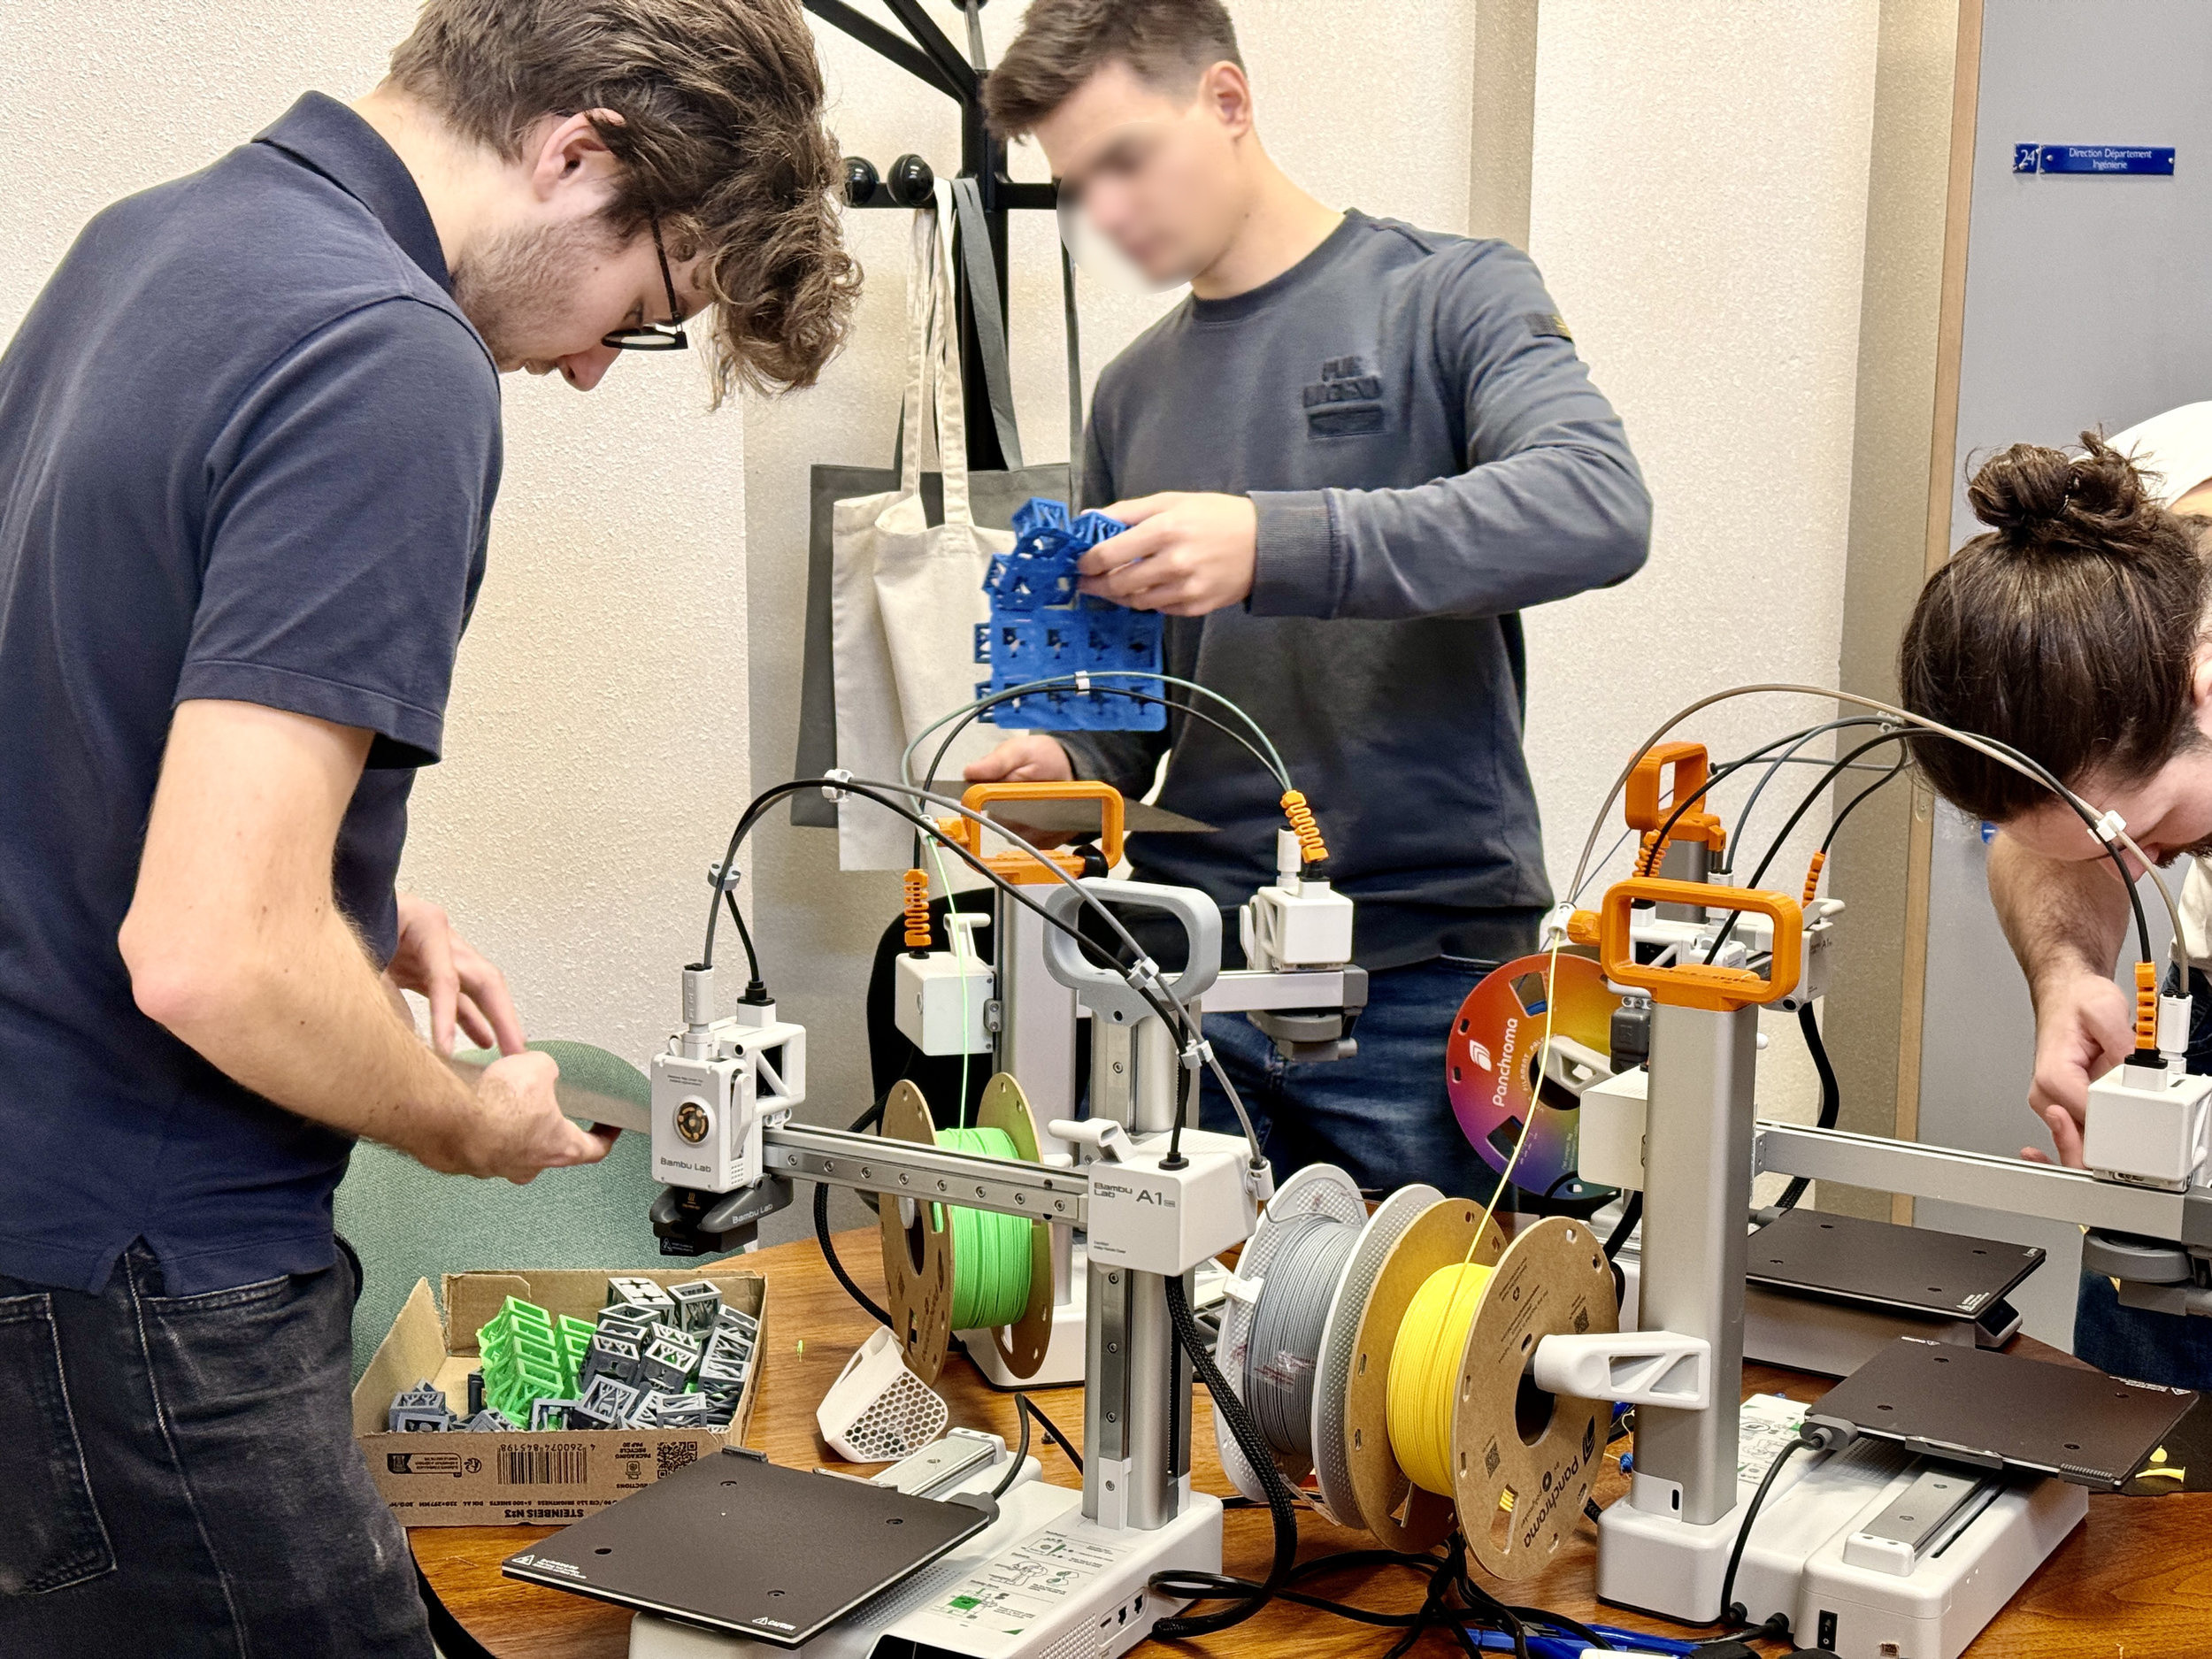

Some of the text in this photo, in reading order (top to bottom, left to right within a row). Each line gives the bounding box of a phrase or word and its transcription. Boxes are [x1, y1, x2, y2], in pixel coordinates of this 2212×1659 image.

[2020, 149, 2035, 166] 24
[2069, 148, 2152, 159] Direction Département
[1492, 1018, 1518, 1108] Panchroma
[660, 1156, 711, 1172] Bambu Lab
[1094, 1182, 1133, 1194] Bambu
[1094, 1188, 1116, 1198] Lab
[1136, 1189, 1162, 1206] A1
[732, 1203, 773, 1224] Bambu Lab
[1523, 1458, 1579, 1548] Panchroma
[526, 1509, 584, 1518] STEINBEIS
